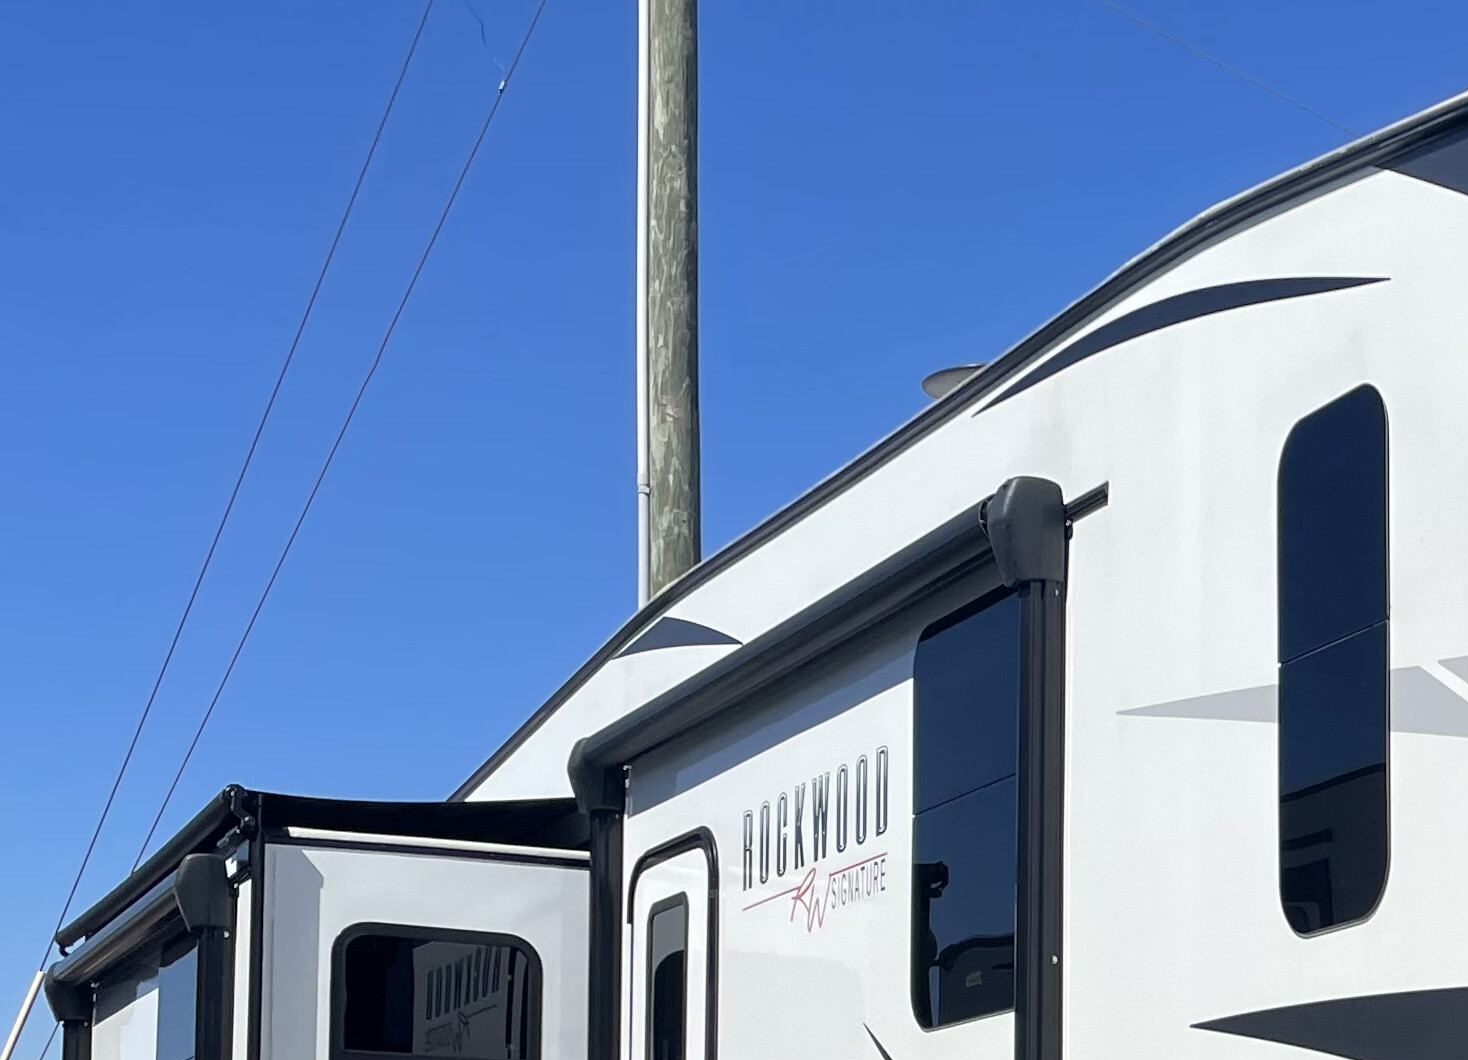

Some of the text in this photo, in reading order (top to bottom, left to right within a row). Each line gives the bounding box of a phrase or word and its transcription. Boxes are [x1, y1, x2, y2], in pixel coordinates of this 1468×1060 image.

[742, 746, 888, 891] ROCKWOOD
[790, 858, 886, 934] RW SIGNATURE
